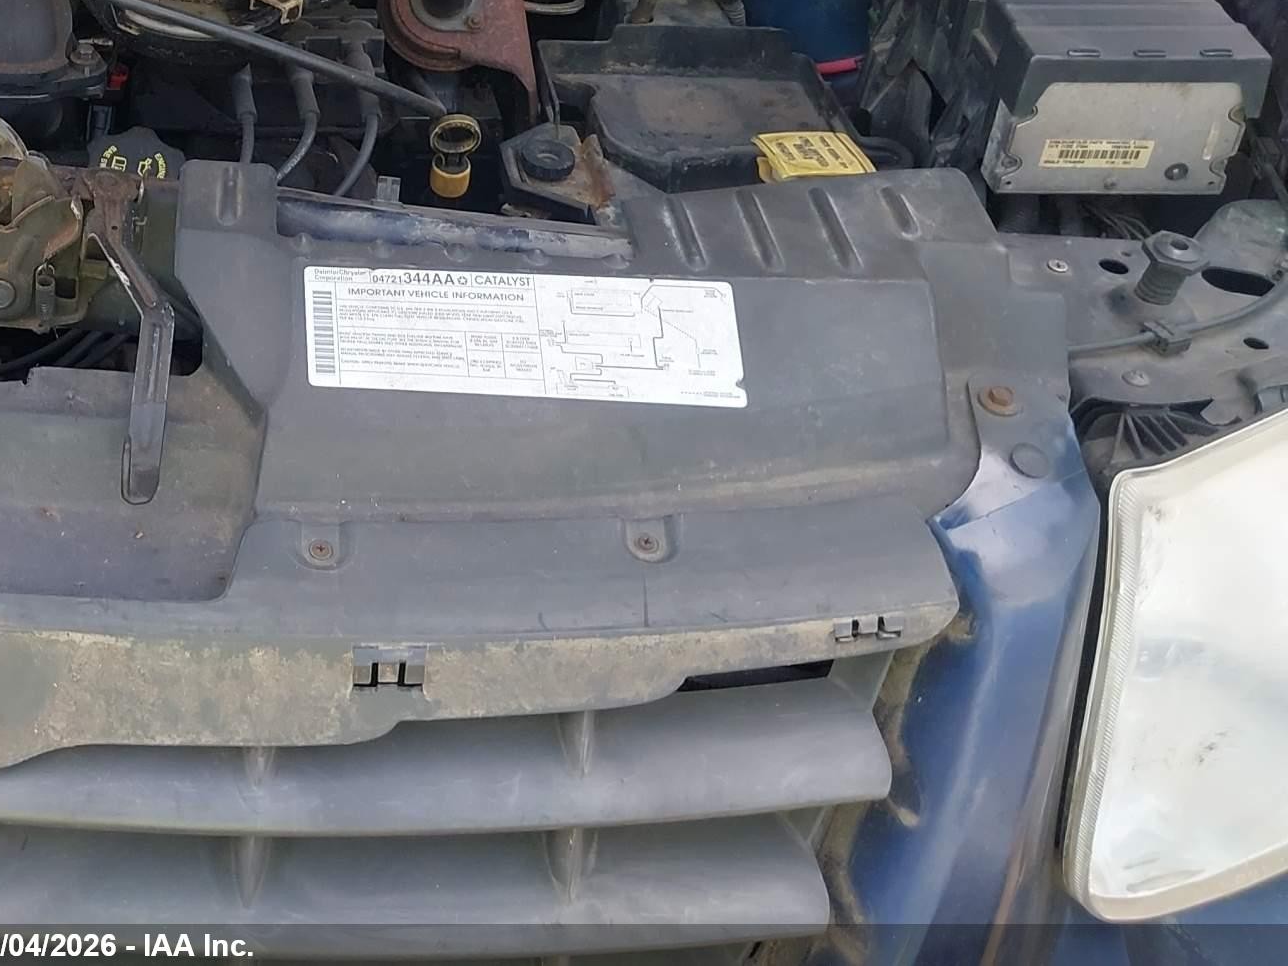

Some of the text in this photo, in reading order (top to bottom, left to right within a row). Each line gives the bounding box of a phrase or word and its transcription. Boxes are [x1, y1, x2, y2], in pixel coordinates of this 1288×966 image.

[475, 275, 530, 286] CATALYST
[348, 288, 524, 301] IMPORTANT VEHICLE INFORMATION
